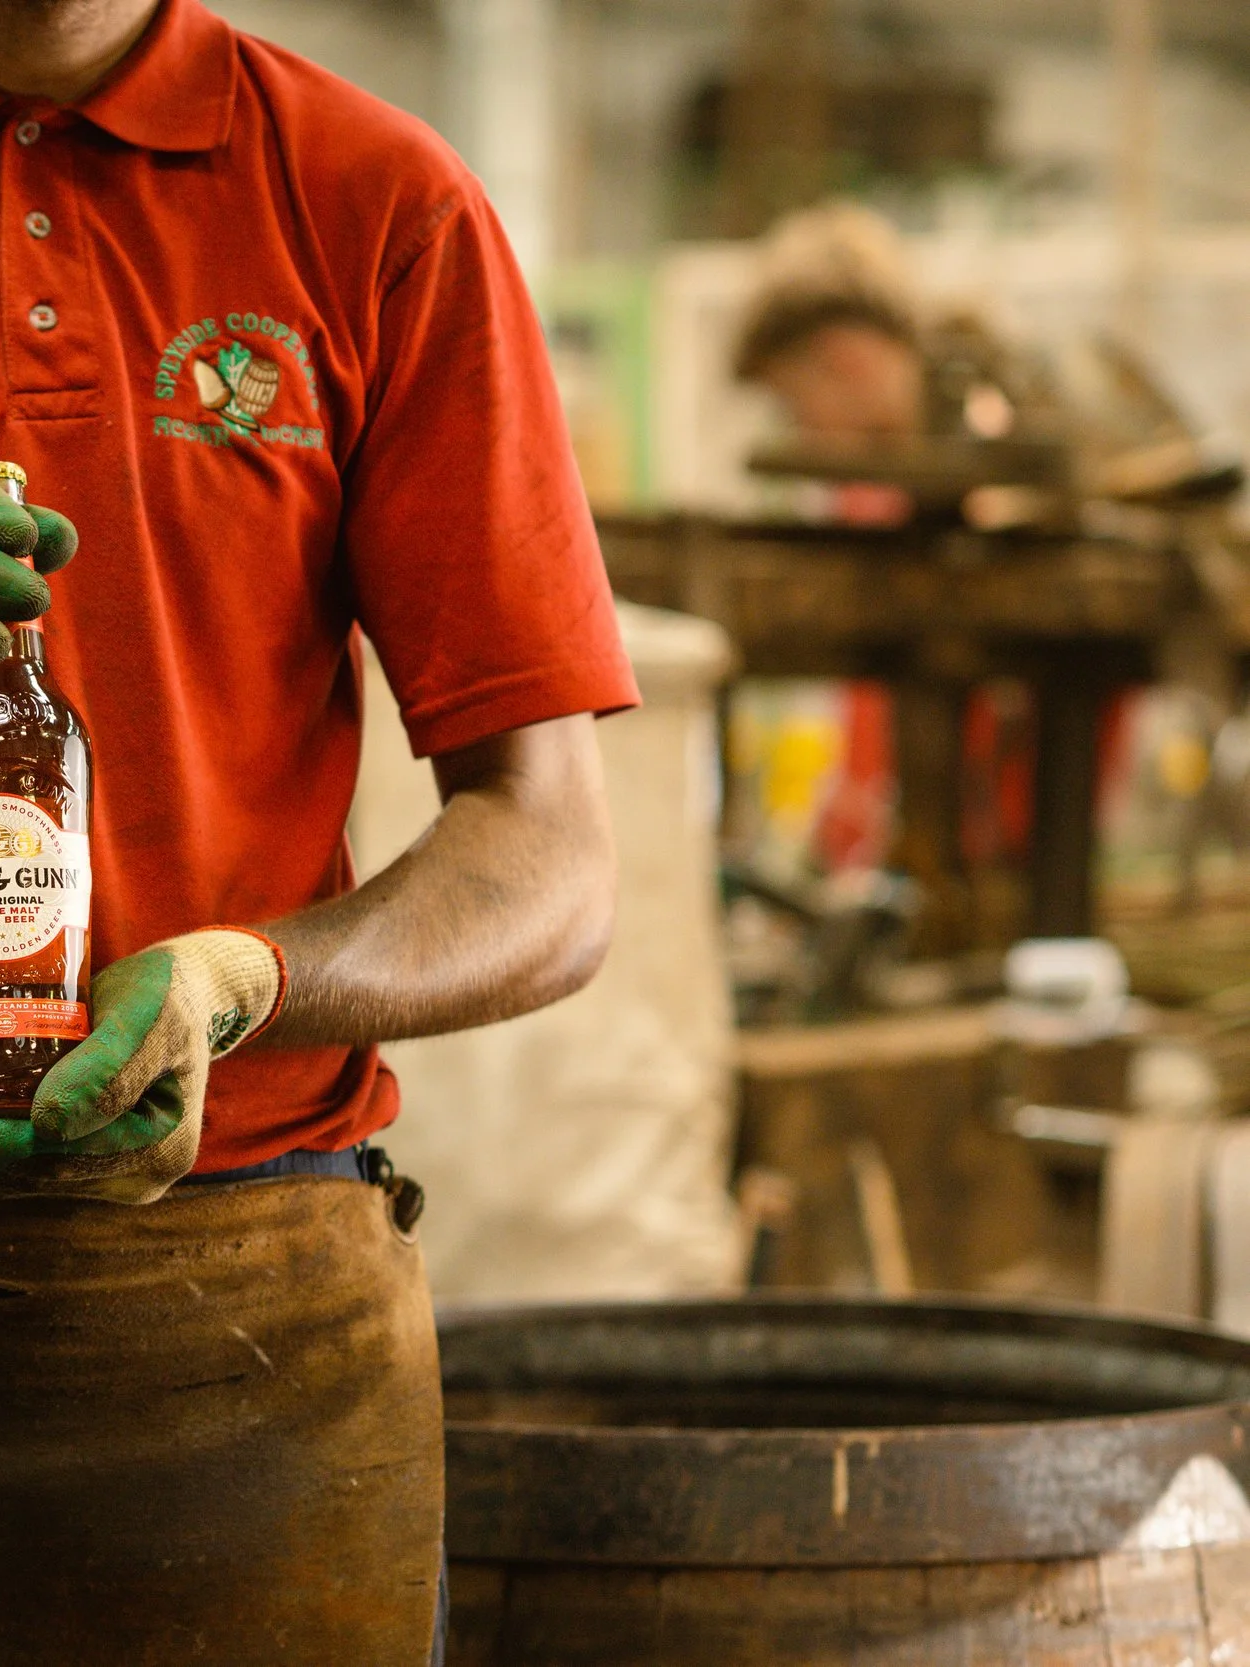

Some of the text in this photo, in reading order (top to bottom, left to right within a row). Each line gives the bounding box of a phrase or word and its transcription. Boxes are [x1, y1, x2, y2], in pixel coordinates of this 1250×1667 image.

[155, 318, 220, 399] SPEYSIDE
[1, 803, 63, 855] SMOOTHNESS
[15, 867, 78, 890] GUNN
[4, 915, 35, 924] BEER
[10, 906, 41, 915] MALT
[44, 908, 63, 935] BEER
[32, 1003, 59, 1011] SINCE
